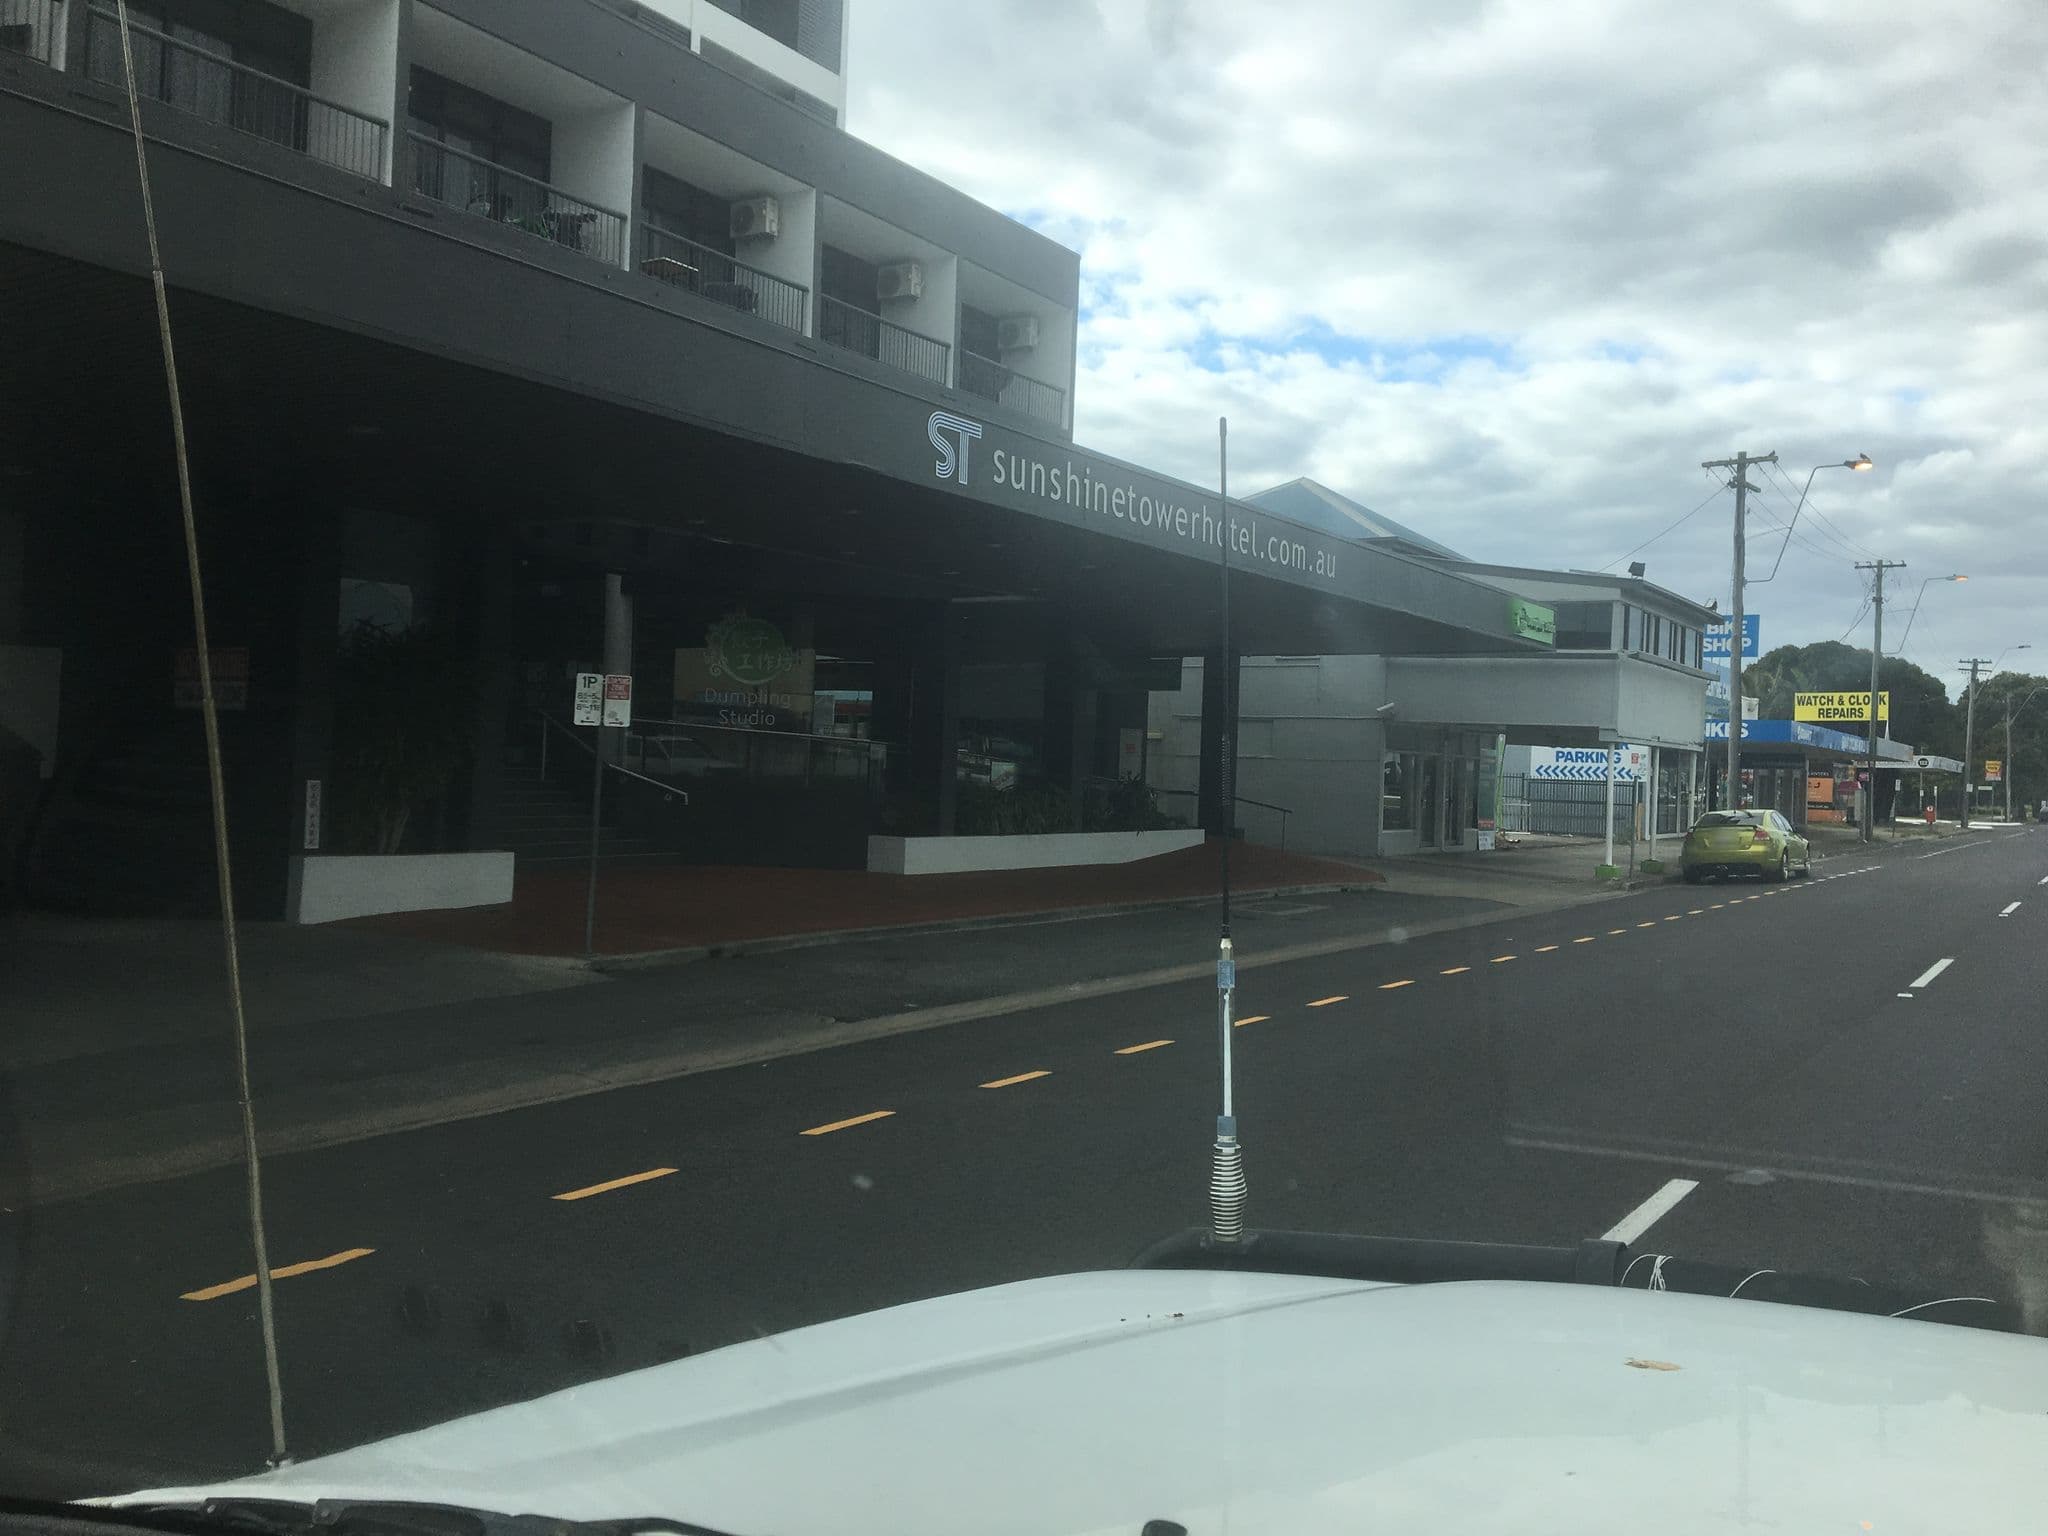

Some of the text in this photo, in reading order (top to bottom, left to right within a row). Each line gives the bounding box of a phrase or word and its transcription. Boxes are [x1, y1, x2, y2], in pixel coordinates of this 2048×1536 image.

[927, 410, 983, 485] ST
[583, 676, 598, 688] 1P
[704, 687, 792, 709] Dumpling
[1797, 694, 1887, 706] WATCH & CLOK
[719, 709, 776, 726] Studio
[1818, 707, 1864, 719] REPAIRS
[1705, 722, 1749, 738] IKS
[1555, 750, 1622, 764] PARKING
